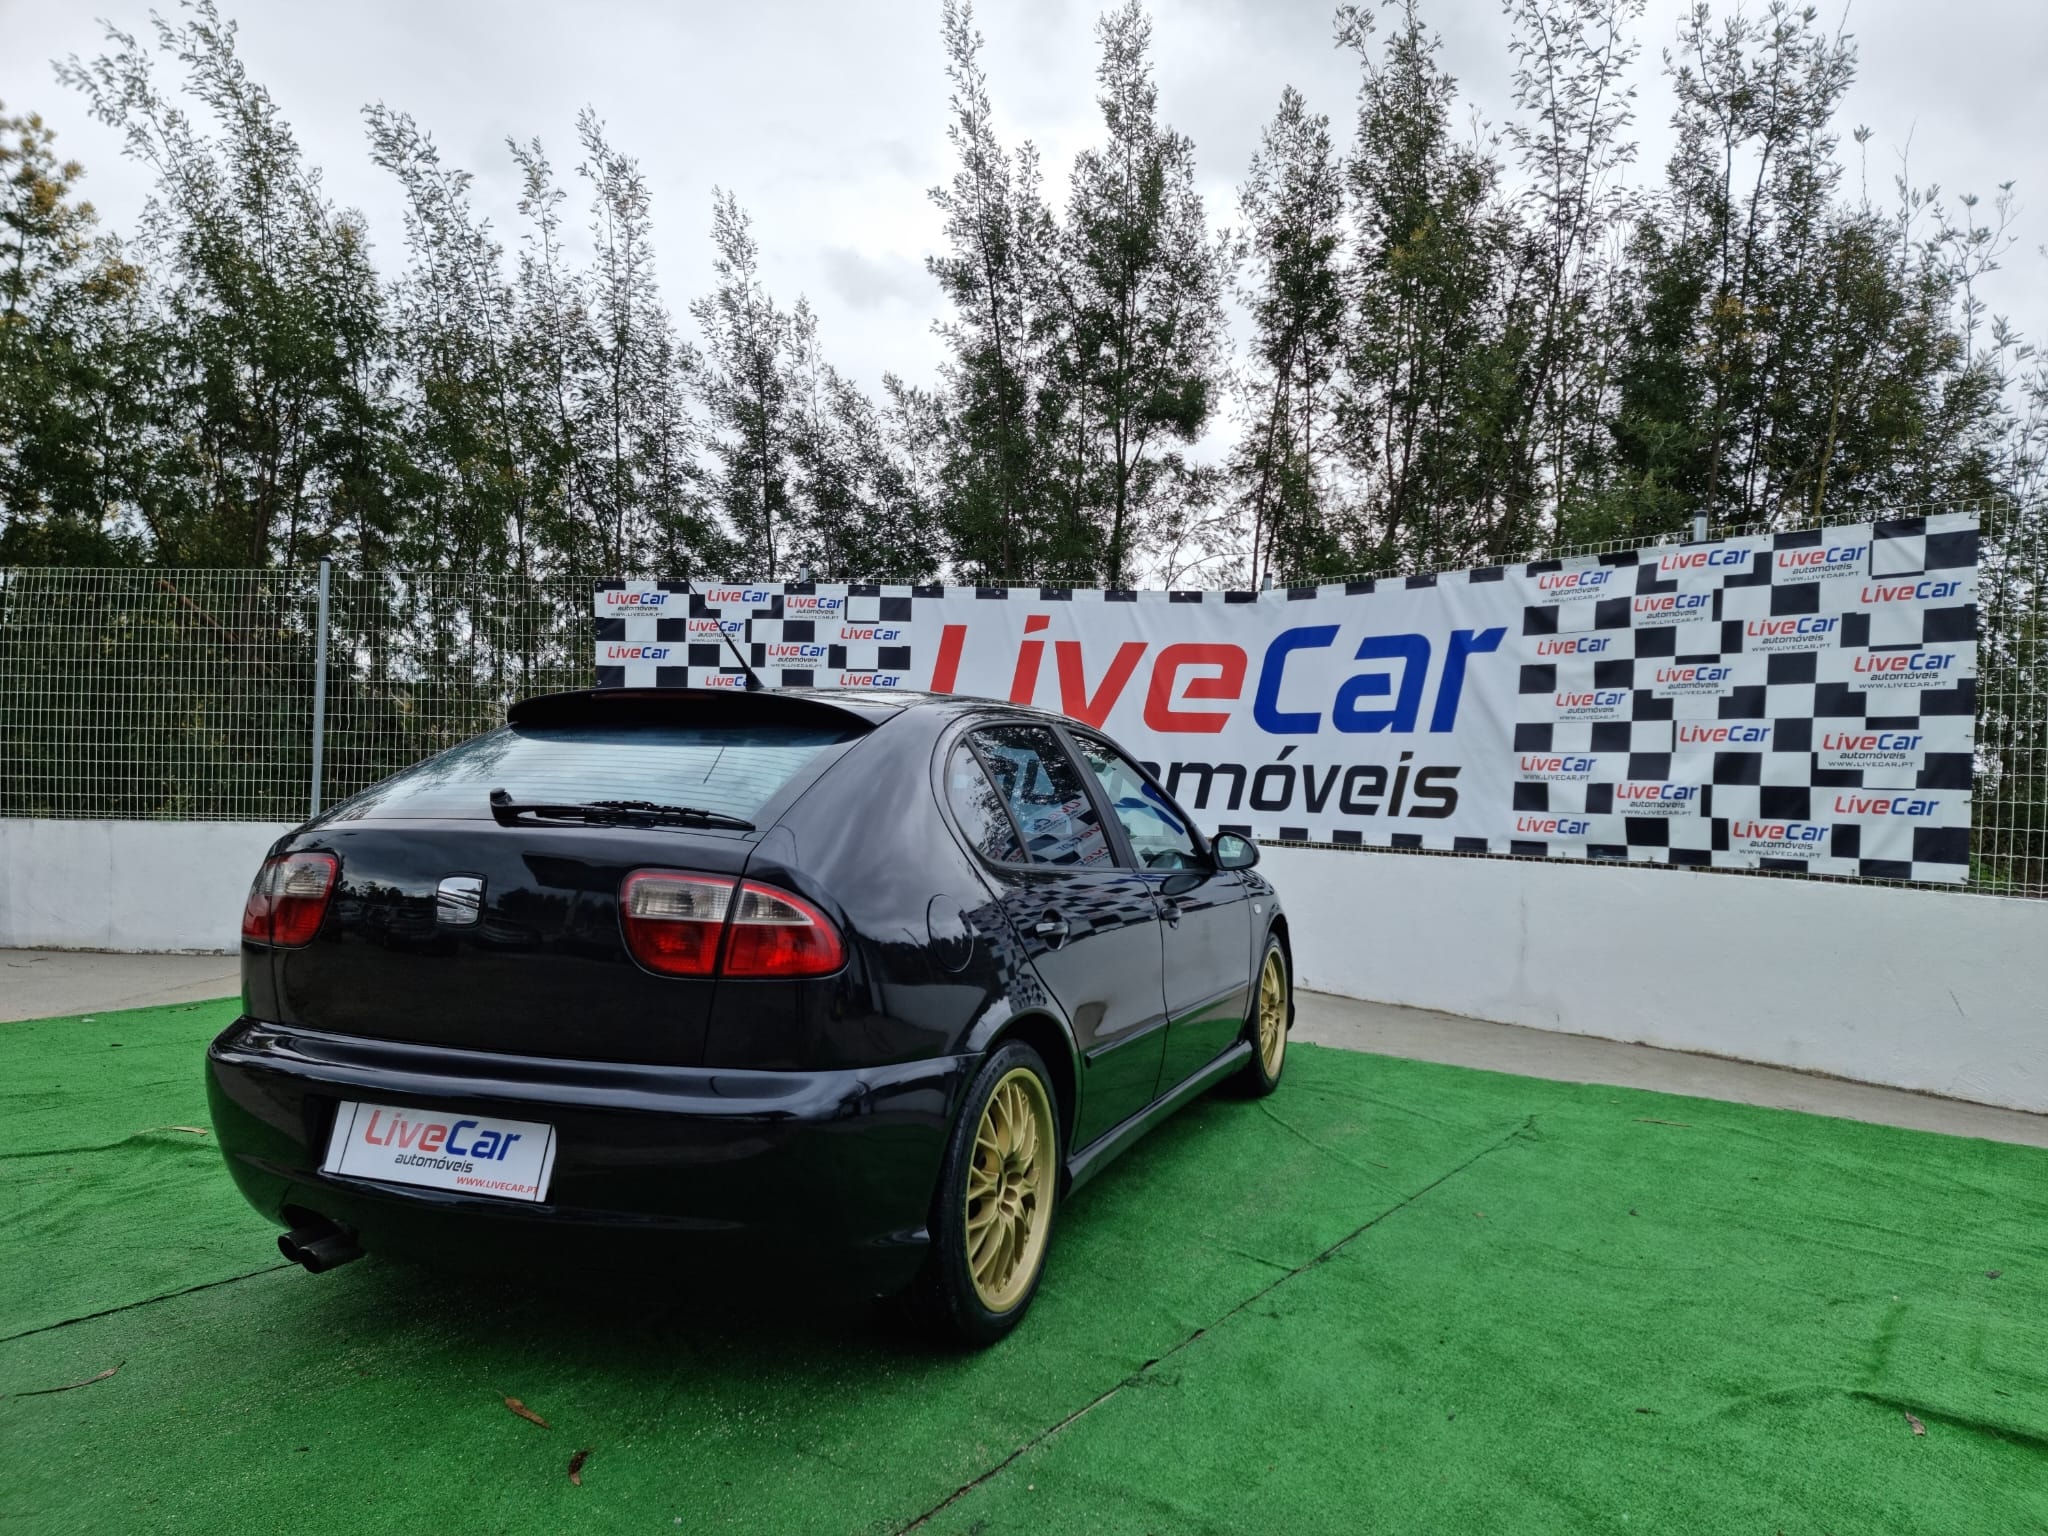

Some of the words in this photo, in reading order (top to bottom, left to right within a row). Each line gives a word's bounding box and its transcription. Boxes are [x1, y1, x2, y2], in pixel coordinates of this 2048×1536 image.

[1661, 547, 1751, 571] LiveCar
[1778, 546, 1867, 567] LiveCar
[1792, 562, 1853, 575] automóveis
[1539, 570, 1614, 590] LiveCar
[607, 591, 669, 605] LiveCar
[707, 588, 770, 602] LiveCar
[1550, 586, 1600, 597] automóveis
[1861, 581, 1962, 604] LiveCar
[787, 594, 843, 609] LiveCar
[1634, 594, 1711, 612] LiveCar
[688, 619, 744, 632] LiveCar
[841, 626, 901, 641] LiveCar
[1747, 617, 1839, 637] LiveCar
[1537, 637, 1610, 656] LiveCar
[1762, 633, 1824, 645] automóveis
[608, 645, 670, 659] LiveCar
[768, 643, 827, 657] LiveCar
[1854, 653, 1956, 673] LiveCar
[840, 673, 900, 687] LiveCar
[1656, 666, 1732, 682] LiveCar
[1870, 671, 1939, 681] automóveis
[1555, 691, 1626, 707] LiveCar
[1679, 725, 1771, 743] LiveCar
[1823, 732, 1923, 751] LiveCar
[1520, 755, 1597, 772] LiveCar
[1840, 750, 1906, 760] automóveis
[1616, 782, 1699, 801] LiveCar
[1629, 800, 1687, 809] automóveis
[1834, 795, 1940, 816] LiveCar
[1516, 816, 1591, 835] LiveCar
[1733, 821, 1829, 842] LiveCar
[1749, 839, 1814, 851] automóveis
[365, 1109, 522, 1161] LiveCar
[394, 1152, 474, 1174] automóveis
[456, 1175, 540, 1196] WWW.LIVECAR.PT
